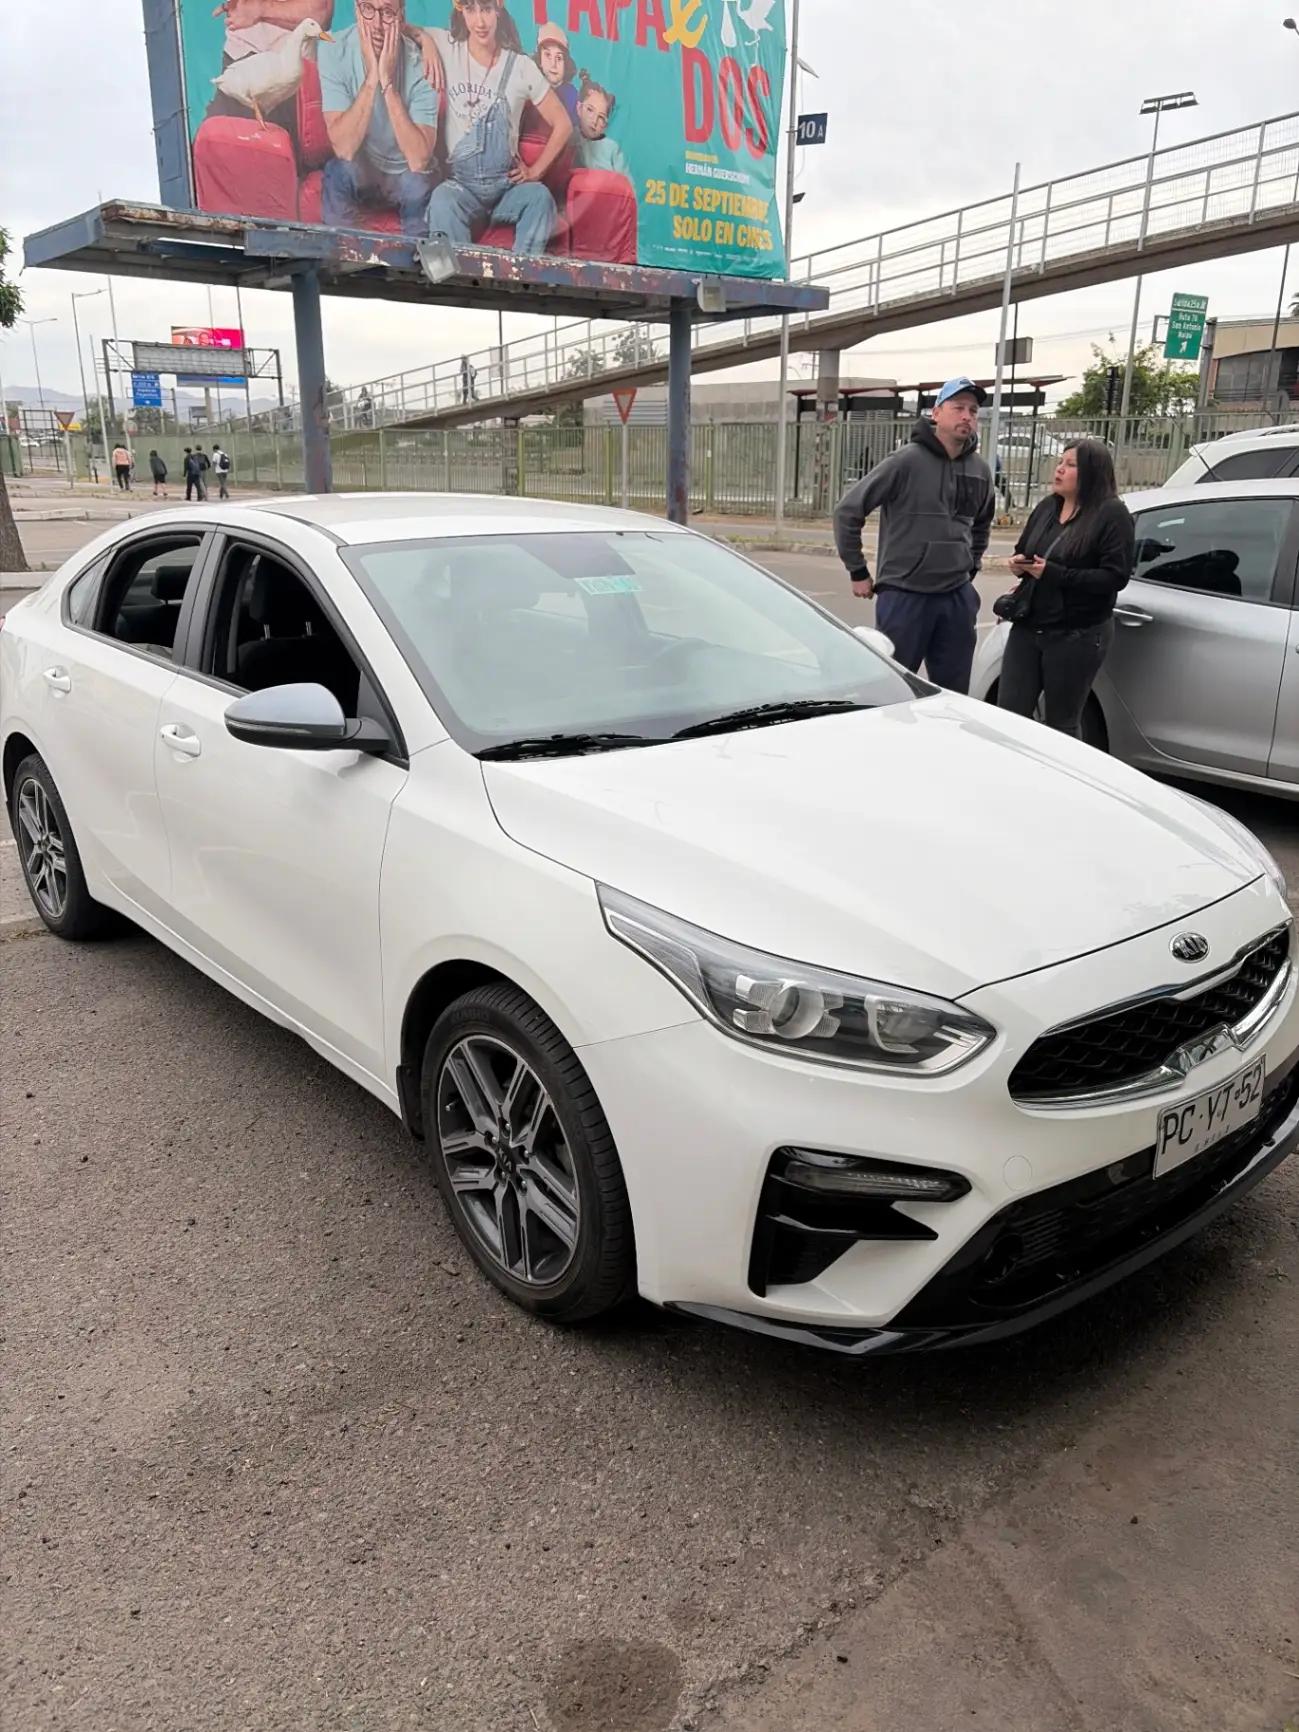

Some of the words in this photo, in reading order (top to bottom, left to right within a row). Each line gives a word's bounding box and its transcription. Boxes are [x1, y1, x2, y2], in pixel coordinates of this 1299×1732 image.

[448, 82, 492, 101] FLORIDA
[681, 48, 770, 159] DOS
[799, 121, 816, 139] 10
[817, 125, 824, 138] A
[646, 179, 666, 205] 25
[669, 184, 689, 208] DE
[673, 215, 713, 243] SOLO
[715, 221, 734, 245] EN
